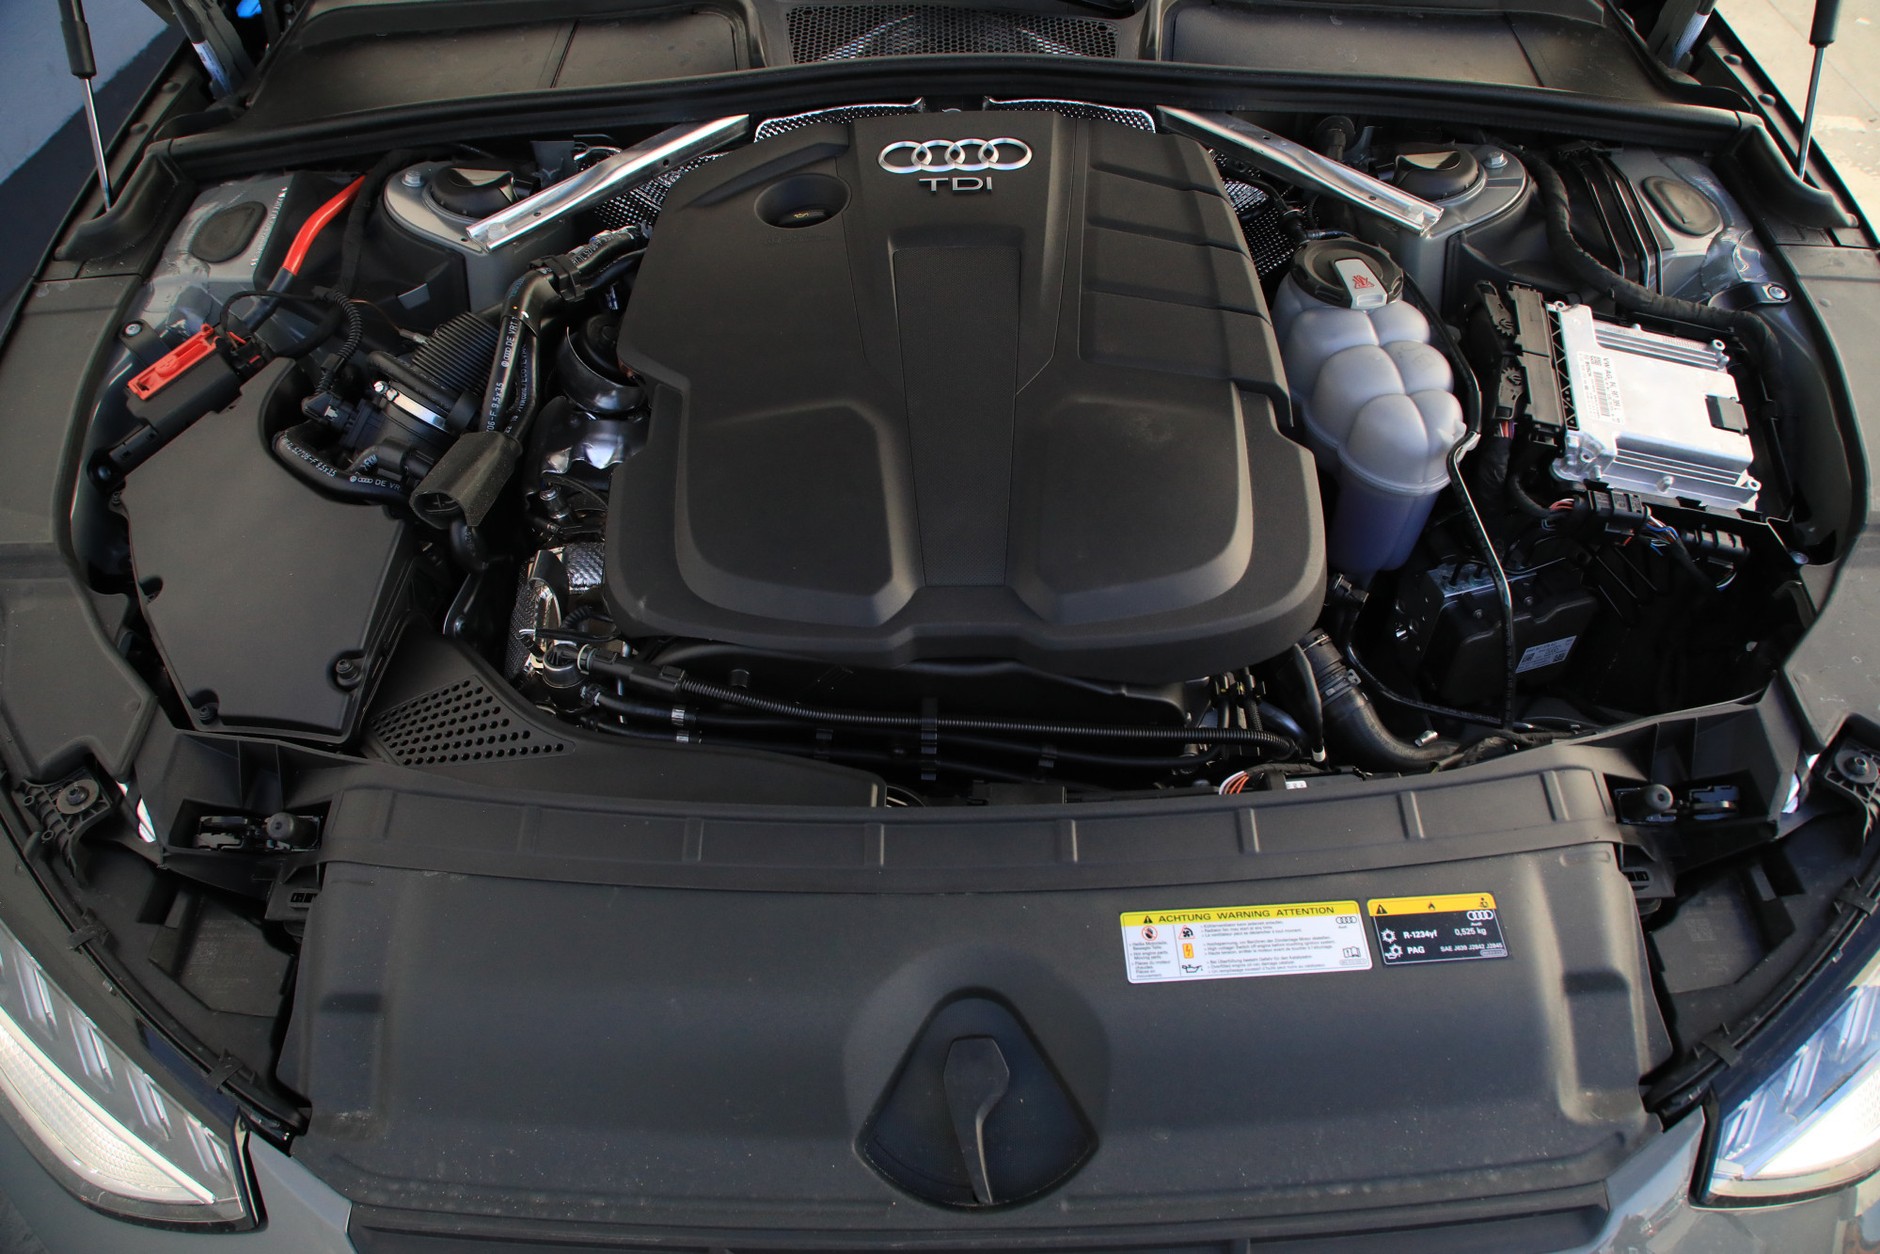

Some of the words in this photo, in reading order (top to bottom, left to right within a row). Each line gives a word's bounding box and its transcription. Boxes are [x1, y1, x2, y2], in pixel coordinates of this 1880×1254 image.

[918, 176, 993, 192] TDI
[1158, 912, 1211, 923] ACHTUNG
[1216, 909, 1270, 920] WARNING
[1276, 905, 1335, 917] ATTENTION
[1402, 929, 1437, 939] R-1234yf
[1454, 927, 1476, 936] 0,525
[1476, 927, 1487, 936] kg
[1406, 945, 1426, 955] PAG
